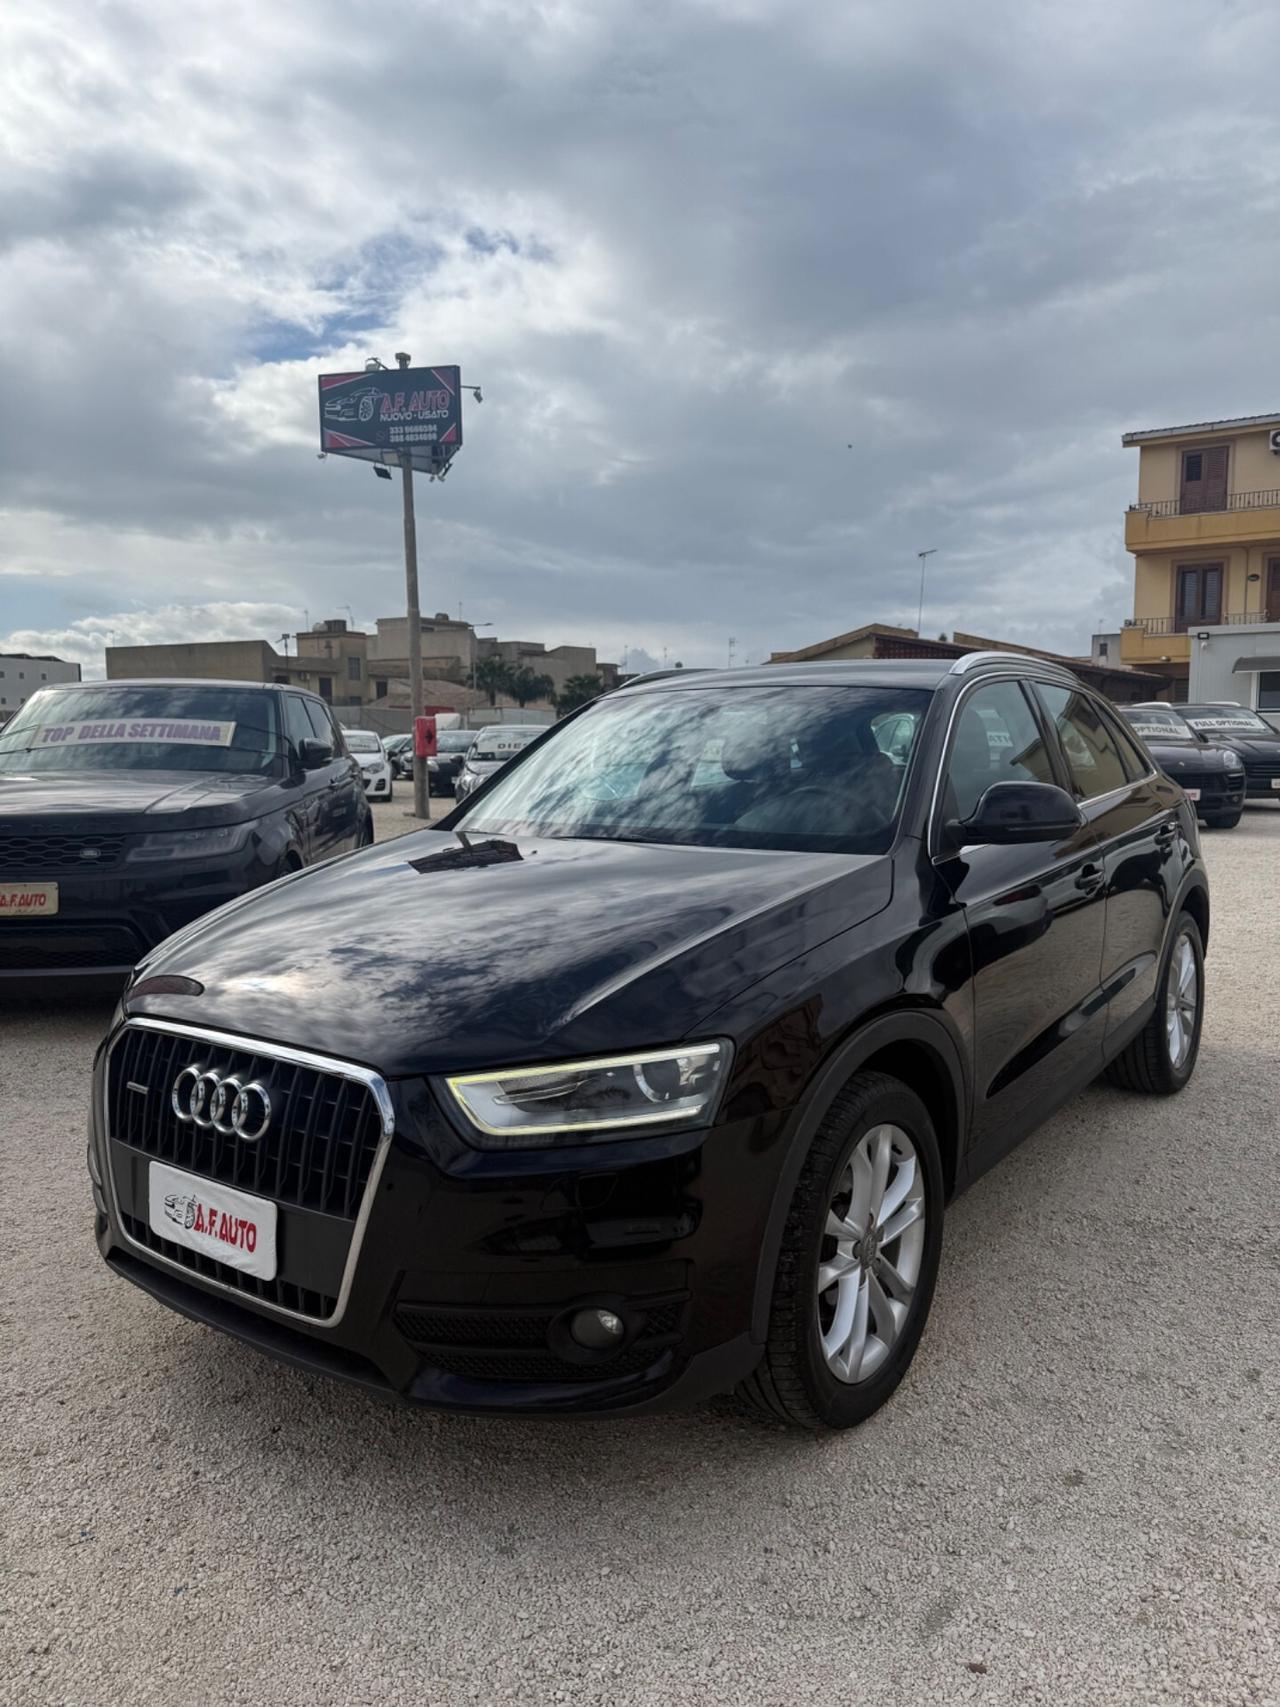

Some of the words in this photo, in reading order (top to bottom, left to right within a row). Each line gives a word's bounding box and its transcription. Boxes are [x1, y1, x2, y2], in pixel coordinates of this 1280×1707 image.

[409, 389, 450, 411] AUTO
[379, 411, 412, 422] NUOVO
[418, 409, 449, 419] USATO
[1194, 720, 1217, 728] FULL
[1216, 719, 1255, 728] OPTIONAL
[42, 727, 75, 743] TOP
[78, 723, 128, 740] DELLA
[128, 722, 221, 741] SETTIMANA
